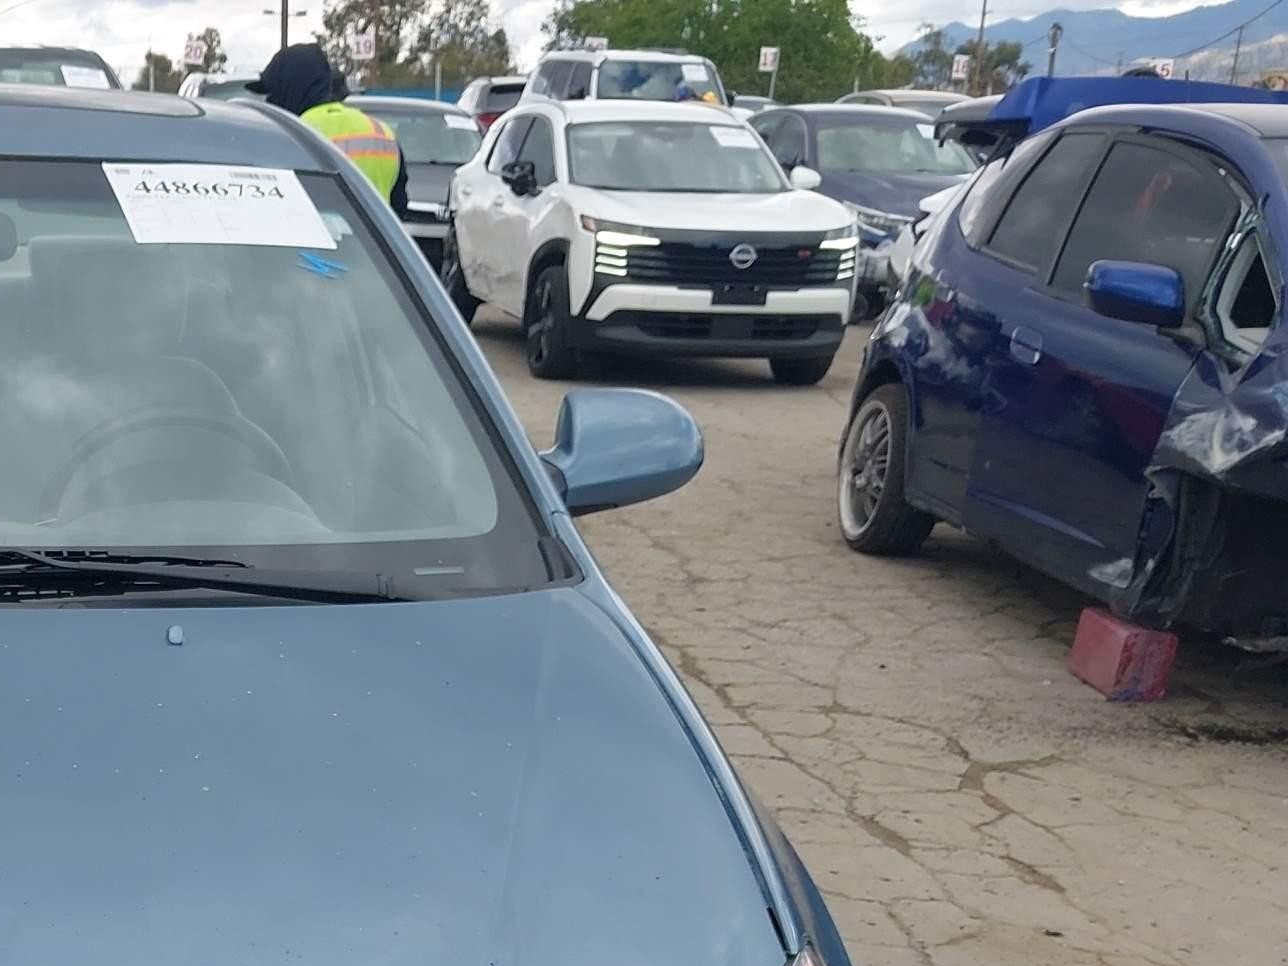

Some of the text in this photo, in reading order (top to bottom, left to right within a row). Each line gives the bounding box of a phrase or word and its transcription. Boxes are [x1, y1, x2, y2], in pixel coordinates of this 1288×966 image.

[184, 44, 202, 60] 20
[355, 39, 372, 55] 19
[134, 180, 285, 200] 44866734
